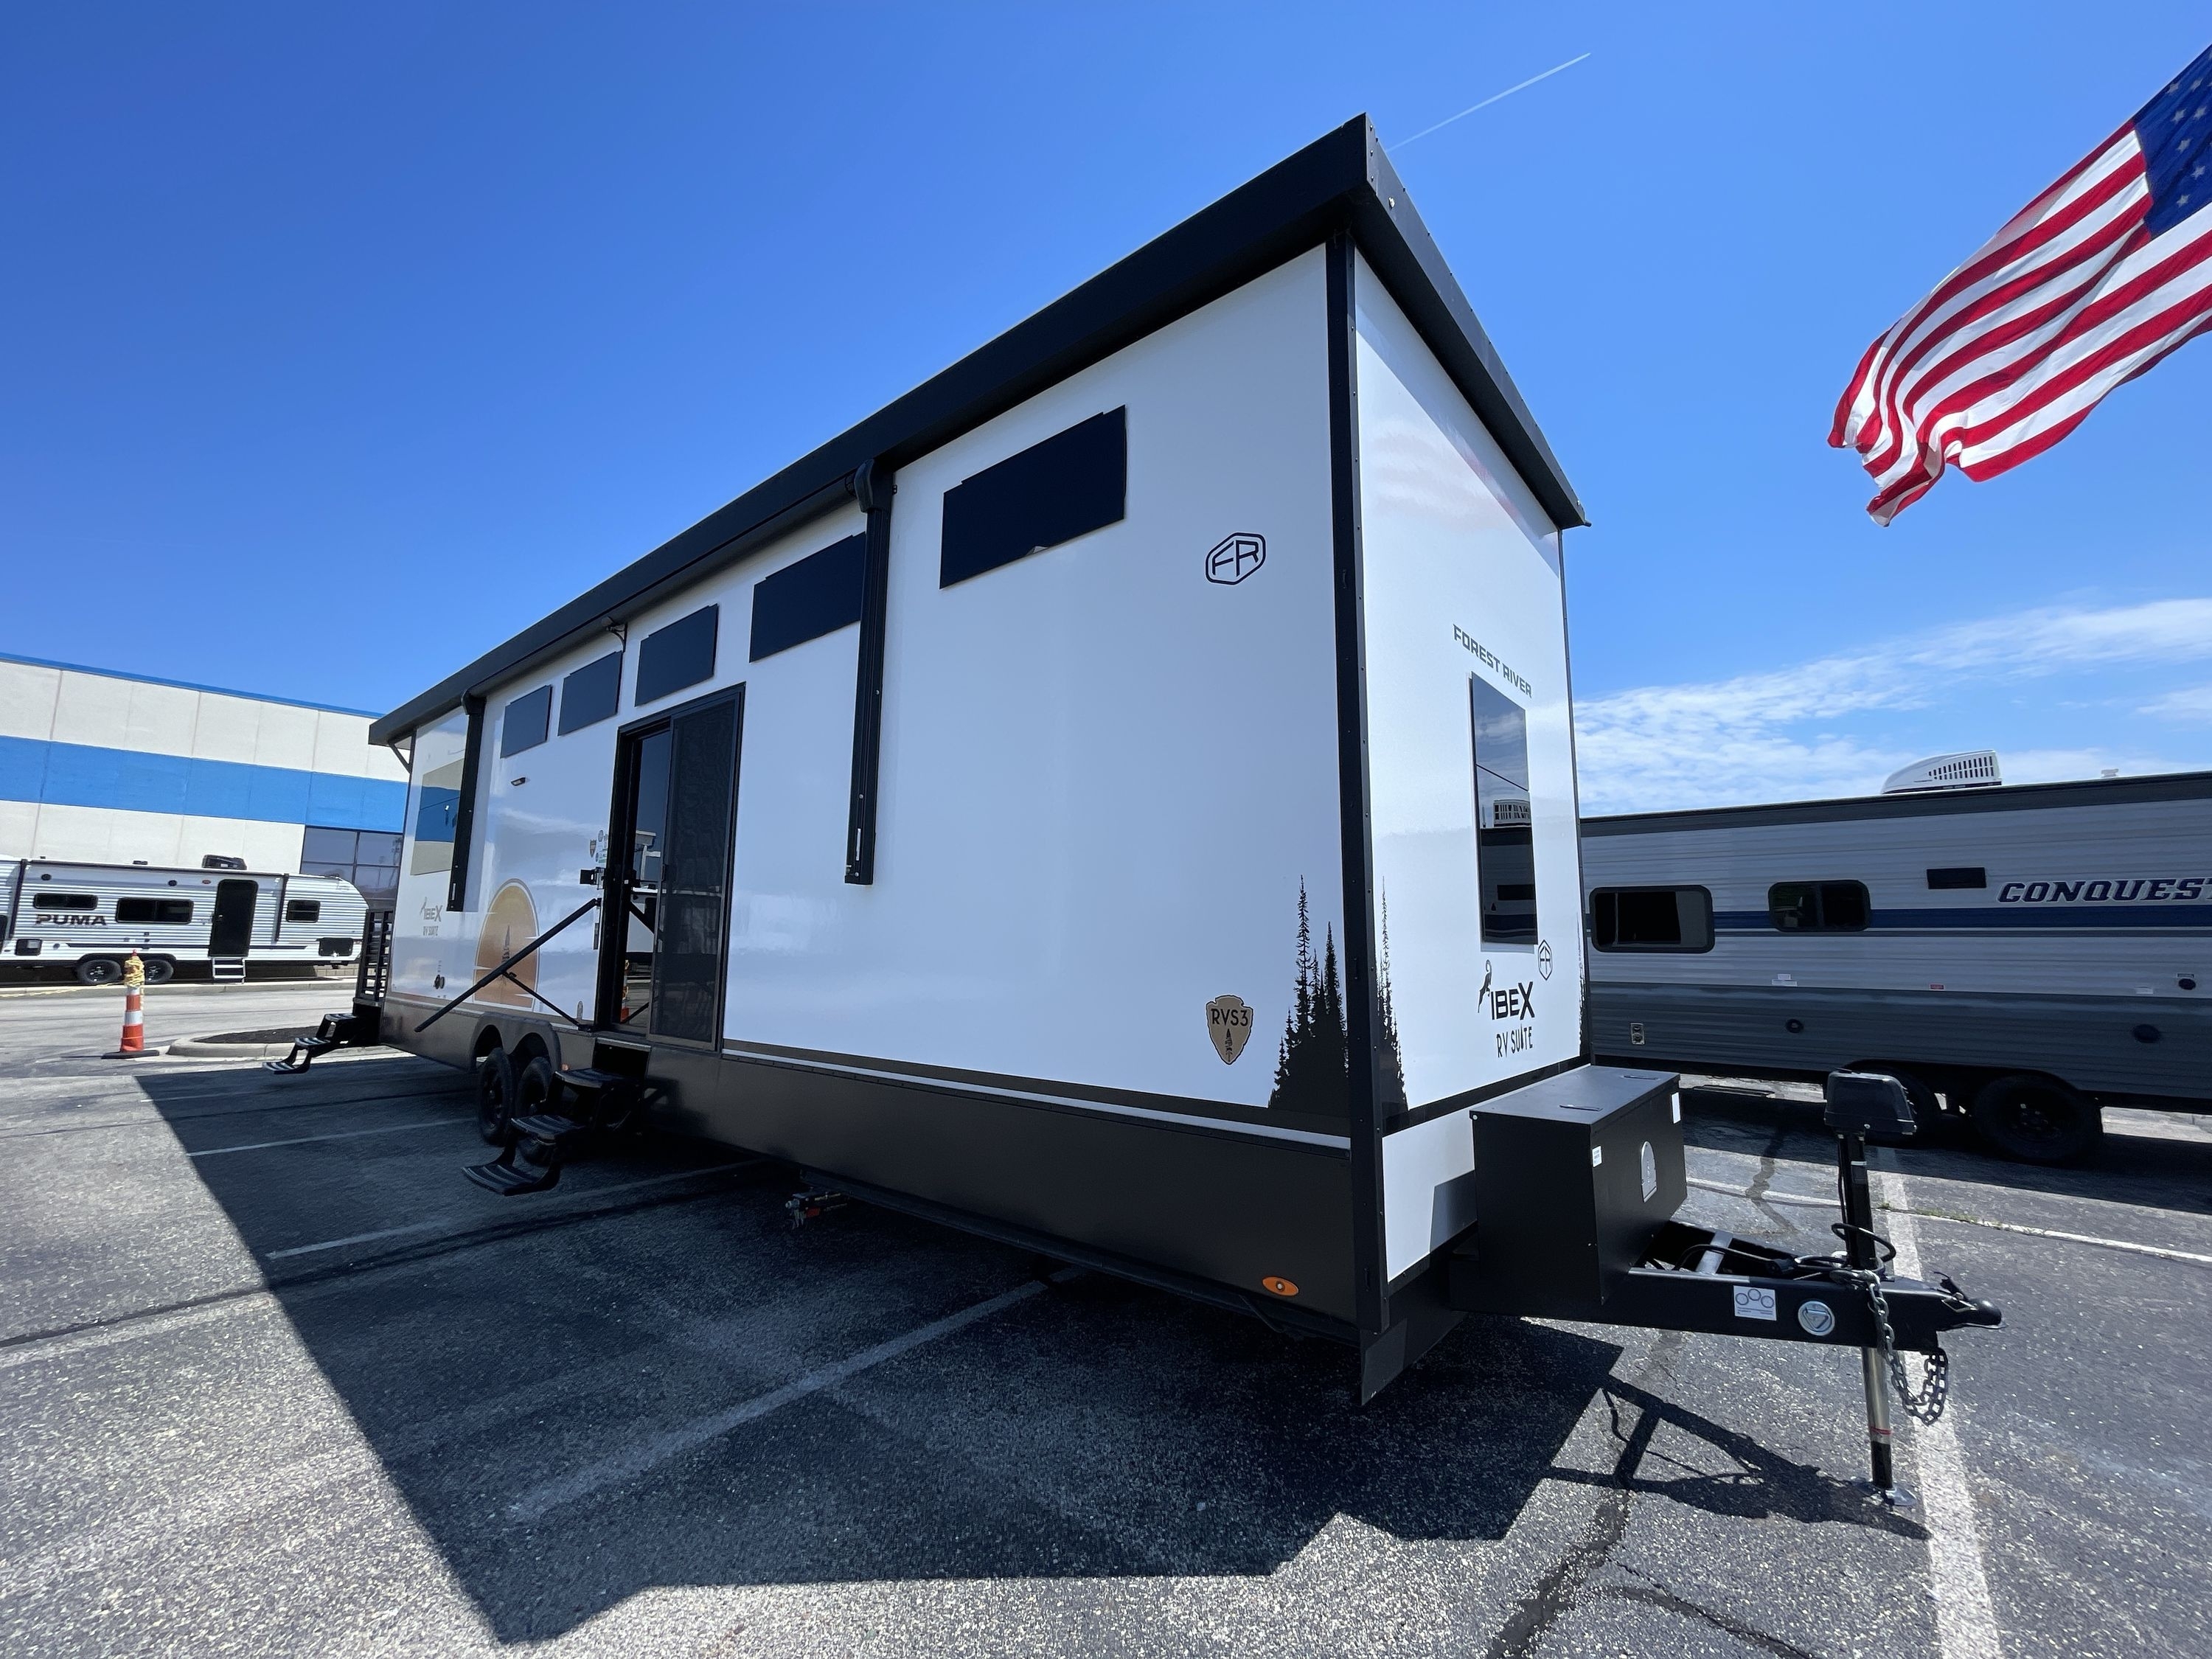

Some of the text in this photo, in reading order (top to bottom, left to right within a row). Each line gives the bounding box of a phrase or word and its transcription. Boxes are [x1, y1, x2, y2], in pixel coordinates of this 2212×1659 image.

[1453, 623, 1532, 699] FOREST RIVER
[1997, 877, 2212, 903] CONQUES
[35, 914, 107, 925] PUMA
[1490, 981, 1535, 1020] IBEX
[1210, 1008, 1249, 1027] RVS3
[1496, 1023, 1533, 1058] RV SUITE
